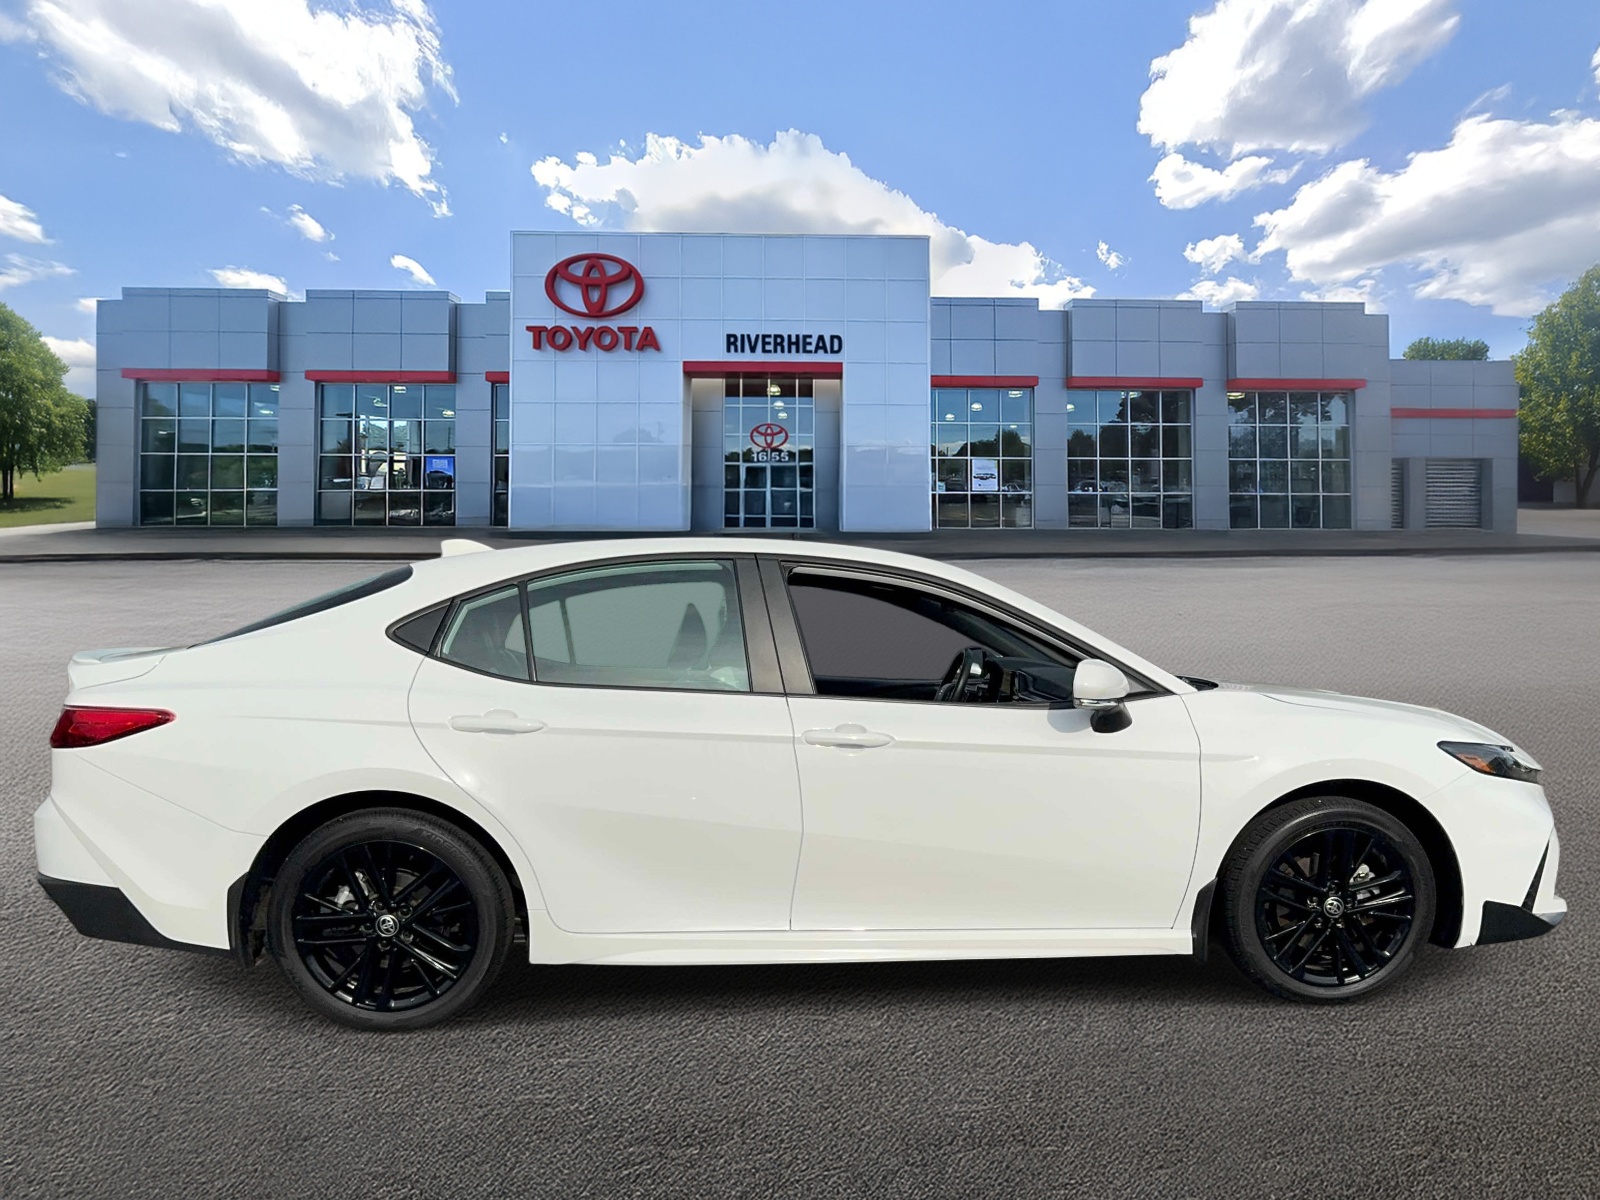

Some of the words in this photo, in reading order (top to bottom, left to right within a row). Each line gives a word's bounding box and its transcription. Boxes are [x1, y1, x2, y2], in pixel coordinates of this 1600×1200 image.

[525, 325, 661, 351] TOYOTA
[726, 333, 843, 354] RIVERHEAD
[752, 451, 789, 462] 1655
